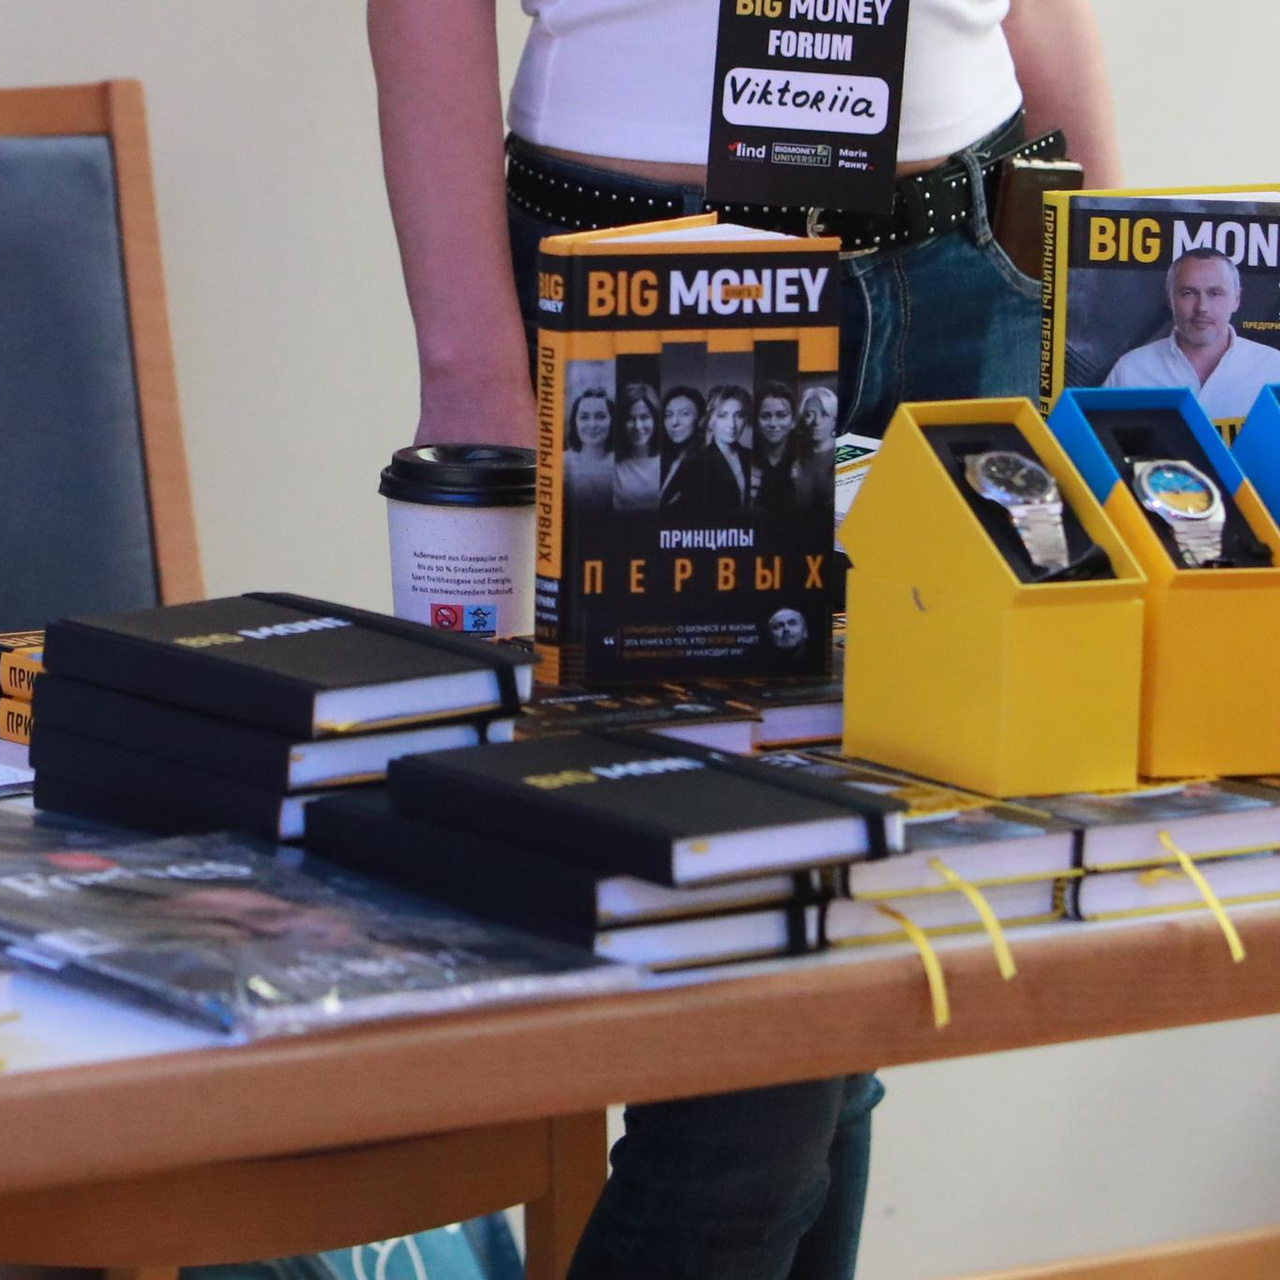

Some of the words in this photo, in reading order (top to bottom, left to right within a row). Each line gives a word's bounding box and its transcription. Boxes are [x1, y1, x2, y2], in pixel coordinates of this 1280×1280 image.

[767, 29, 853, 61] FORUM
[774, 146, 816, 155] BIGMONEY
[774, 154, 828, 164] UNIVERSITY
[1042, 209, 1055, 310] ПРИНЦИПЫ
[1089, 216, 1161, 263] BIG
[1172, 220, 1279, 267] MON
[588, 270, 659, 317] BIG
[669, 268, 829, 316] MONEY
[1040, 318, 1051, 389] ПЕРВЫХ
[539, 346, 555, 469] ПРИНЦИПЫ
[538, 475, 553, 563] ПЕРВЫХ
[660, 528, 754, 550] ПРИНЦИПЫ
[583, 555, 824, 595] ПЕРВЫХ
